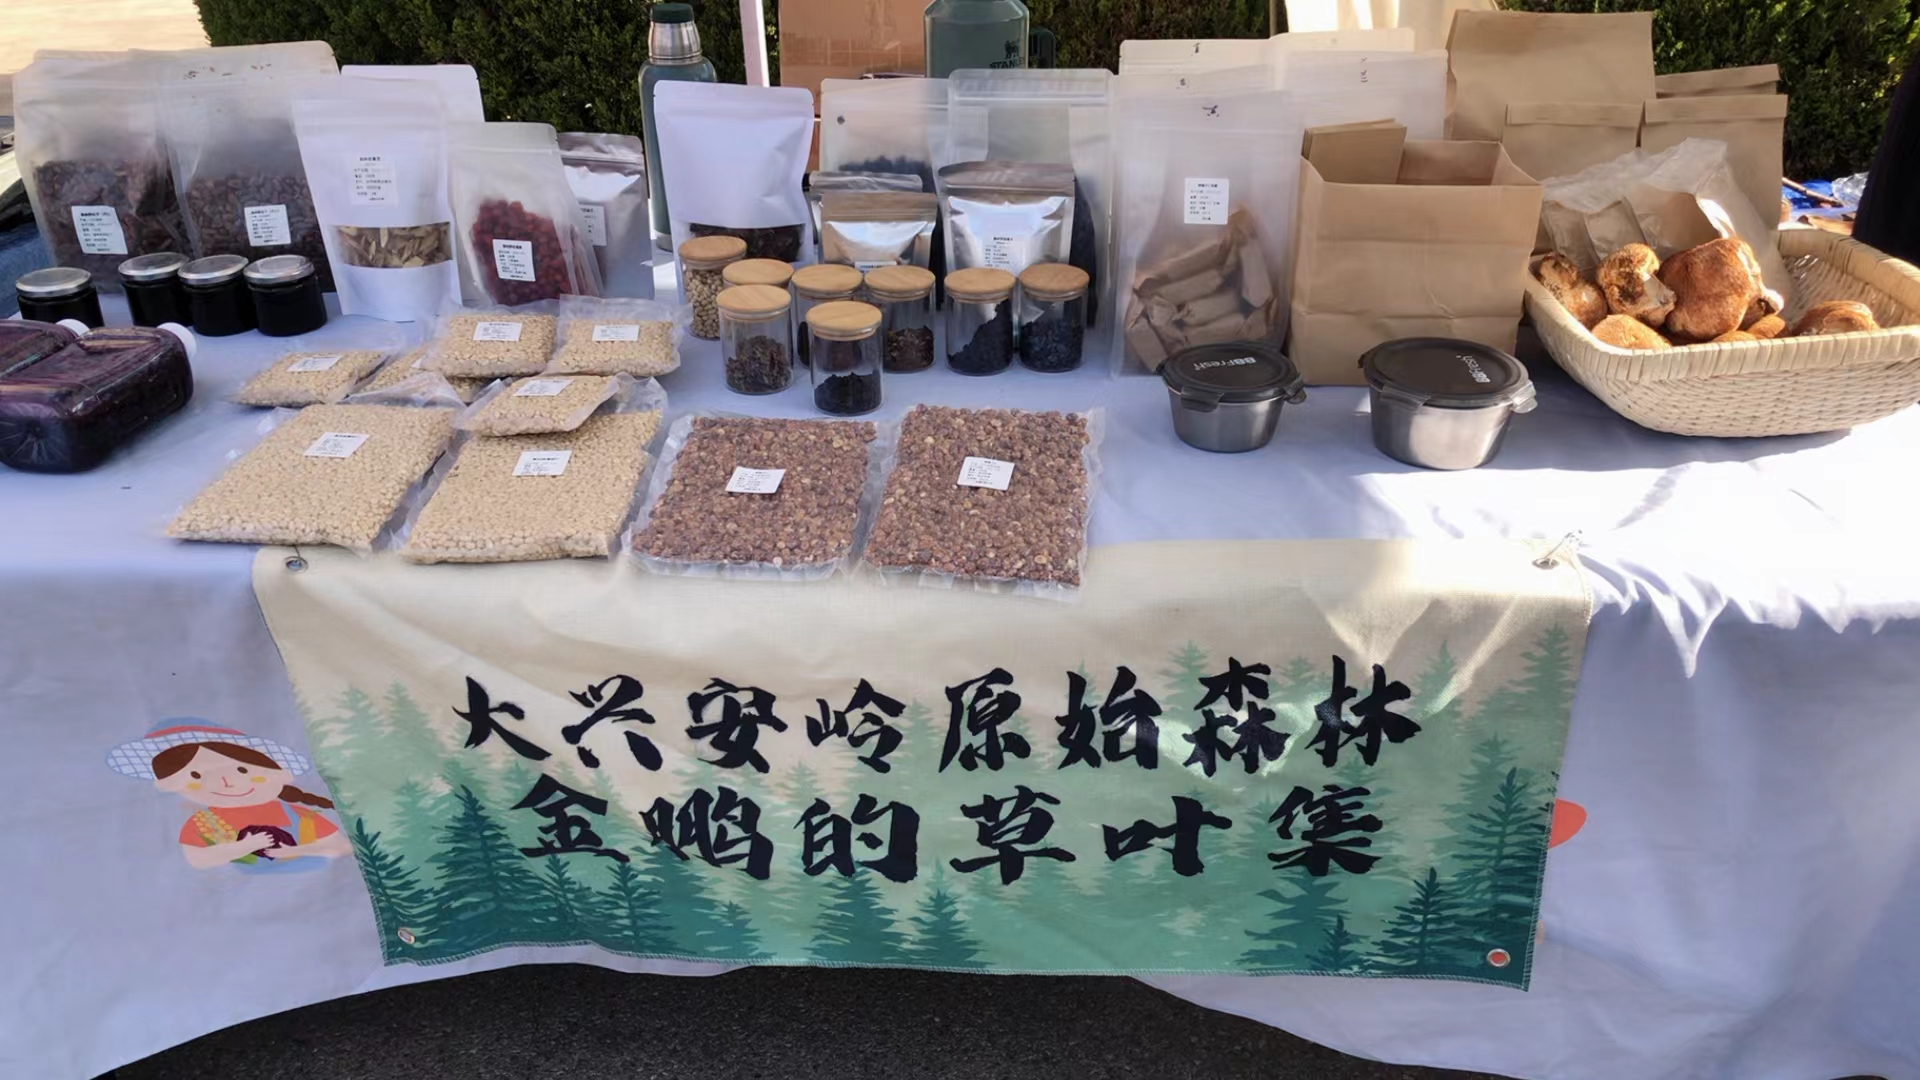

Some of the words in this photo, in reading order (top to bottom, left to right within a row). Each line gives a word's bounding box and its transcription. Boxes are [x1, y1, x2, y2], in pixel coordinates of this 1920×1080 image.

[989, 57, 1025, 69] STANLE
[452, 655, 1422, 776] 大兴安岭原始森林
[510, 773, 1384, 885] 金鹏的草叶集
